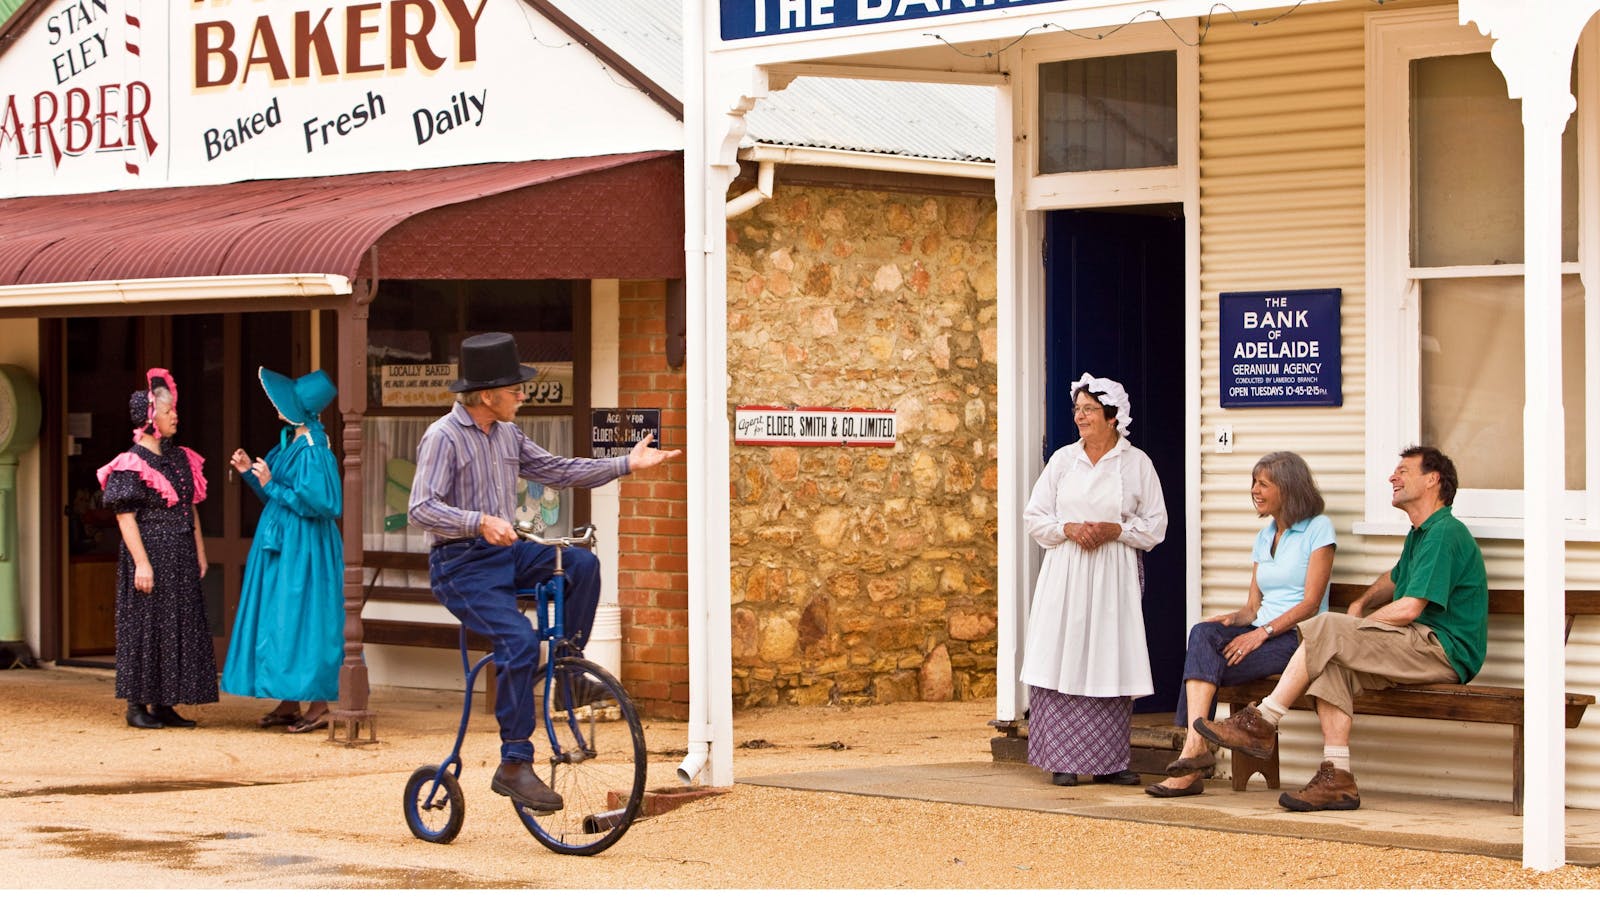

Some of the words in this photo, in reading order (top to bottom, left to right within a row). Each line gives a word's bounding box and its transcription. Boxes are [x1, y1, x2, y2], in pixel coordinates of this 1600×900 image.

[194, 0, 487, 88] BAKERY
[52, 27, 108, 86] ELEY
[203, 97, 282, 161] Baked
[303, 91, 386, 154] Fresh
[412, 88, 487, 146] Daily
[1265, 297, 1287, 308] THE
[1243, 310, 1309, 329] BANK
[1267, 330, 1282, 340] OF
[1233, 340, 1320, 359] ADELAIDE
[389, 366, 421, 377] LOCALLY
[425, 365, 451, 377] BAKED
[1232, 363, 1280, 376] GERANIUM
[1283, 363, 1322, 375] AGENCY
[1229, 386, 1249, 397] OPEN
[1250, 386, 1284, 397] TUESDAYS
[631, 414, 644, 424] FOR
[738, 416, 764, 436] Agent
[766, 415, 796, 437] ELDER,
[799, 416, 827, 437] SMITH
[831, 416, 838, 437] &
[859, 417, 895, 438] LIMITED.
[593, 426, 613, 442] ELDER
[1218, 431, 1229, 446] 4
